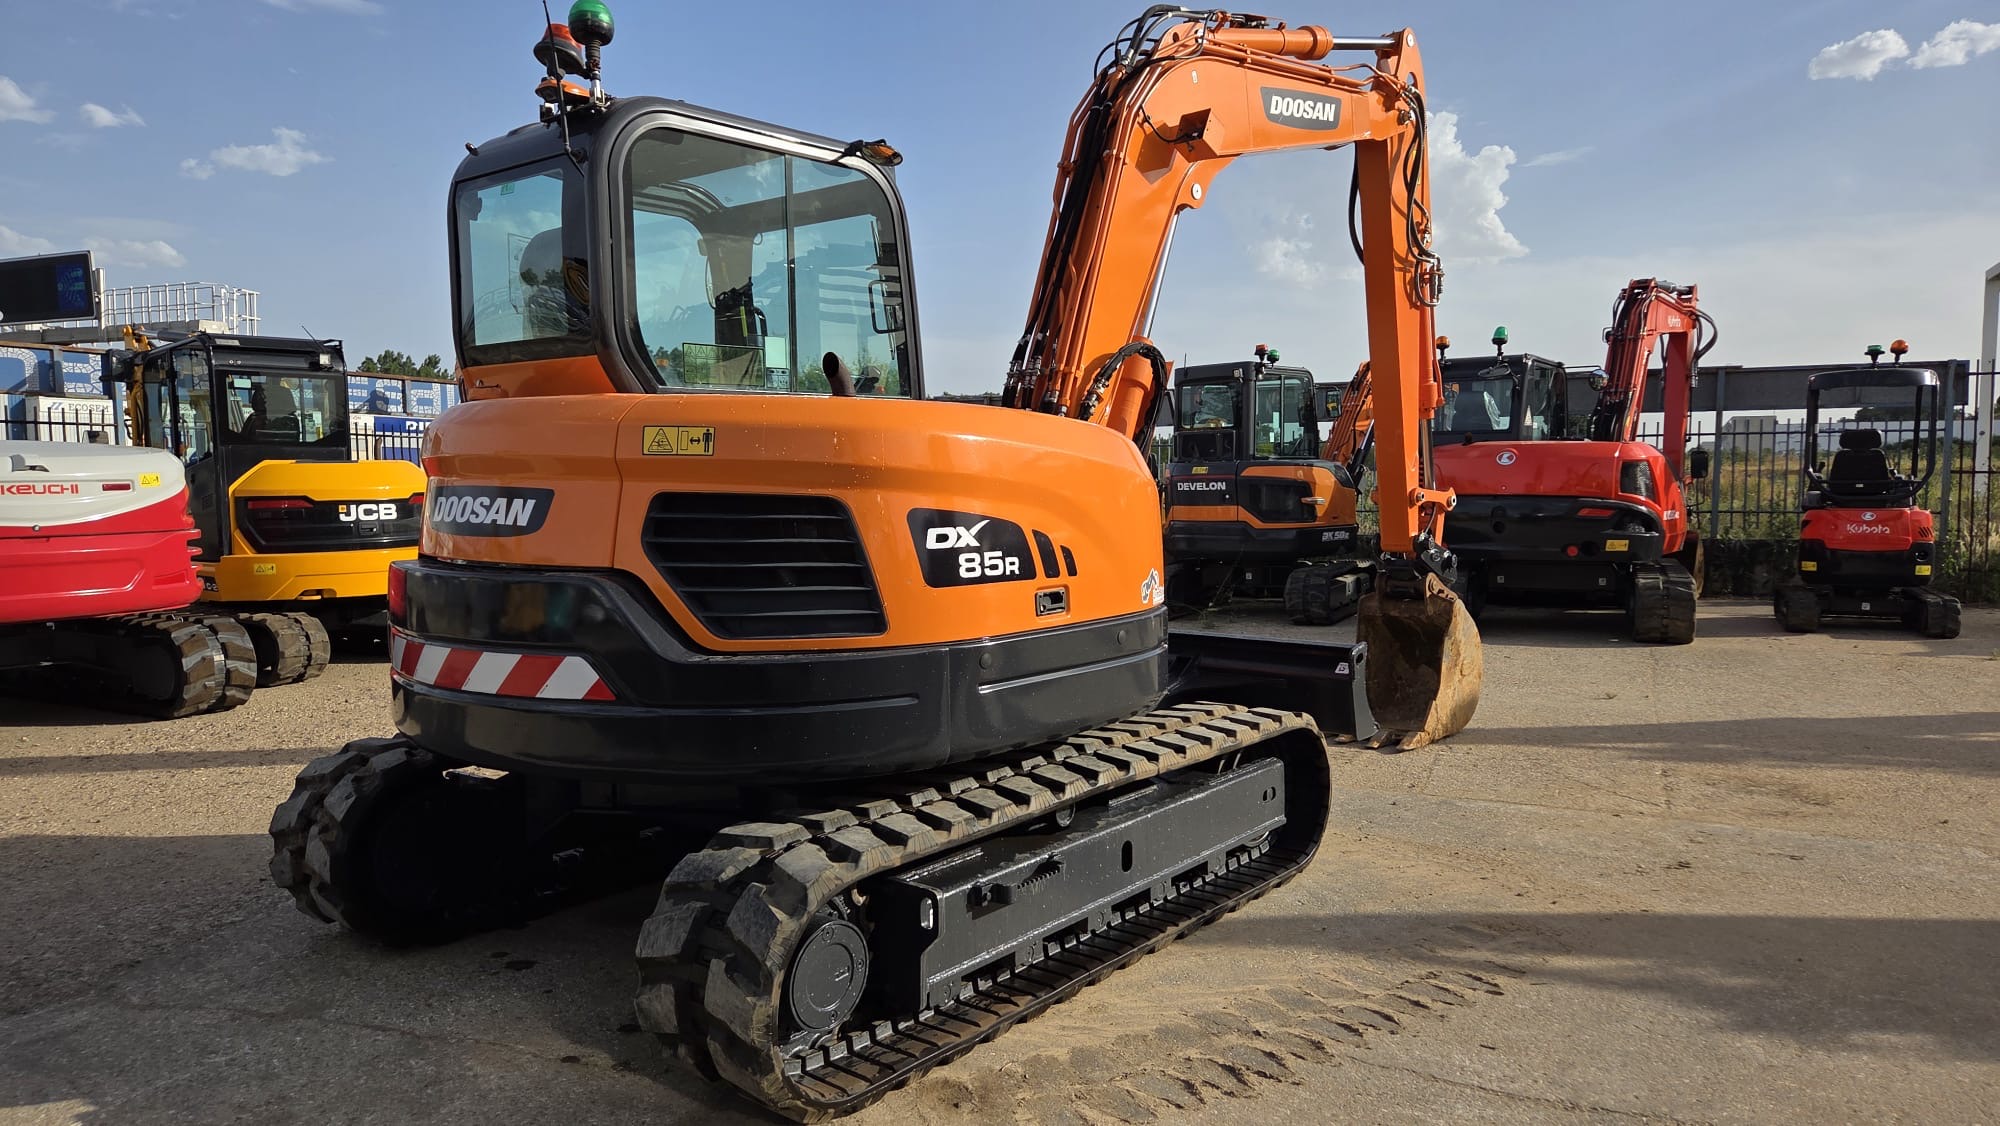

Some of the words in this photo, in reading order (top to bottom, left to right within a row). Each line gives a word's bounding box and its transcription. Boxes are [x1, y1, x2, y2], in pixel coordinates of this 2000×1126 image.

[1270, 95, 1336, 122] DOOSAN
[68, 403, 109, 413] ECOSEM
[1177, 481, 1227, 491] DEVELON
[338, 503, 398, 522] JCB
[433, 496, 537, 527] DOOSAN
[926, 519, 991, 550] DX
[1847, 523, 1890, 534] Kubota
[958, 550, 1020, 578] 85R
